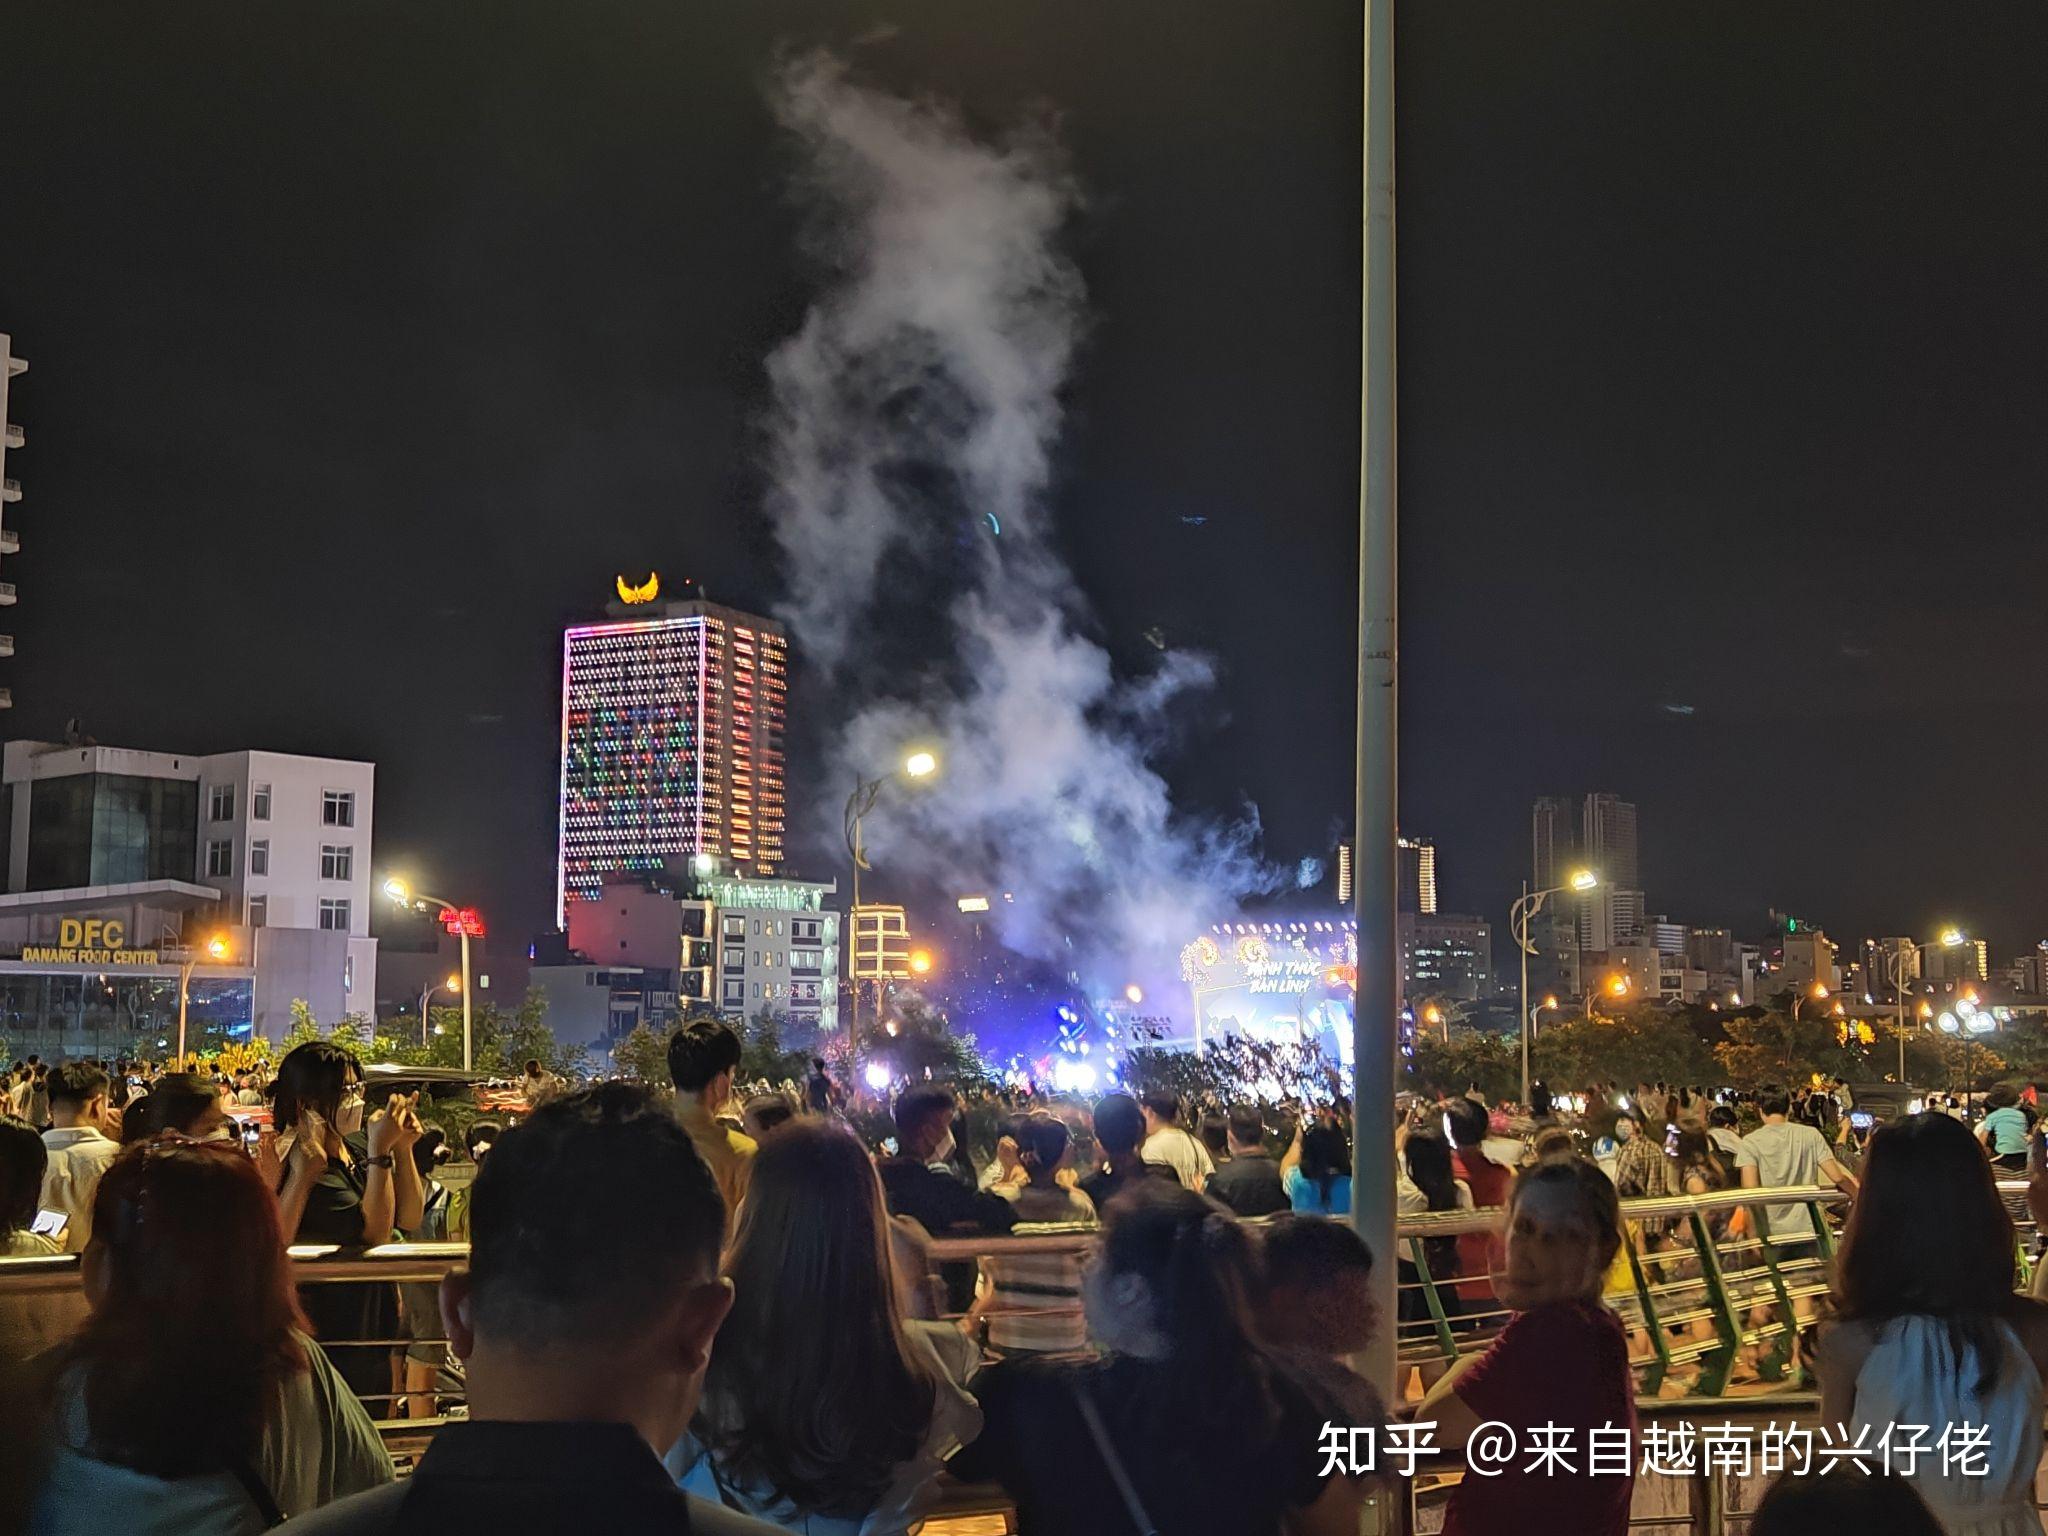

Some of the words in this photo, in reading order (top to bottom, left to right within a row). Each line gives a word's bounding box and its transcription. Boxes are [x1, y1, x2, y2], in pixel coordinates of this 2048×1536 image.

[61, 918, 124, 949] DFC
[23, 947, 77, 963] DANANG
[78, 949, 111, 964] FOOD
[113, 950, 158, 965] CENTER
